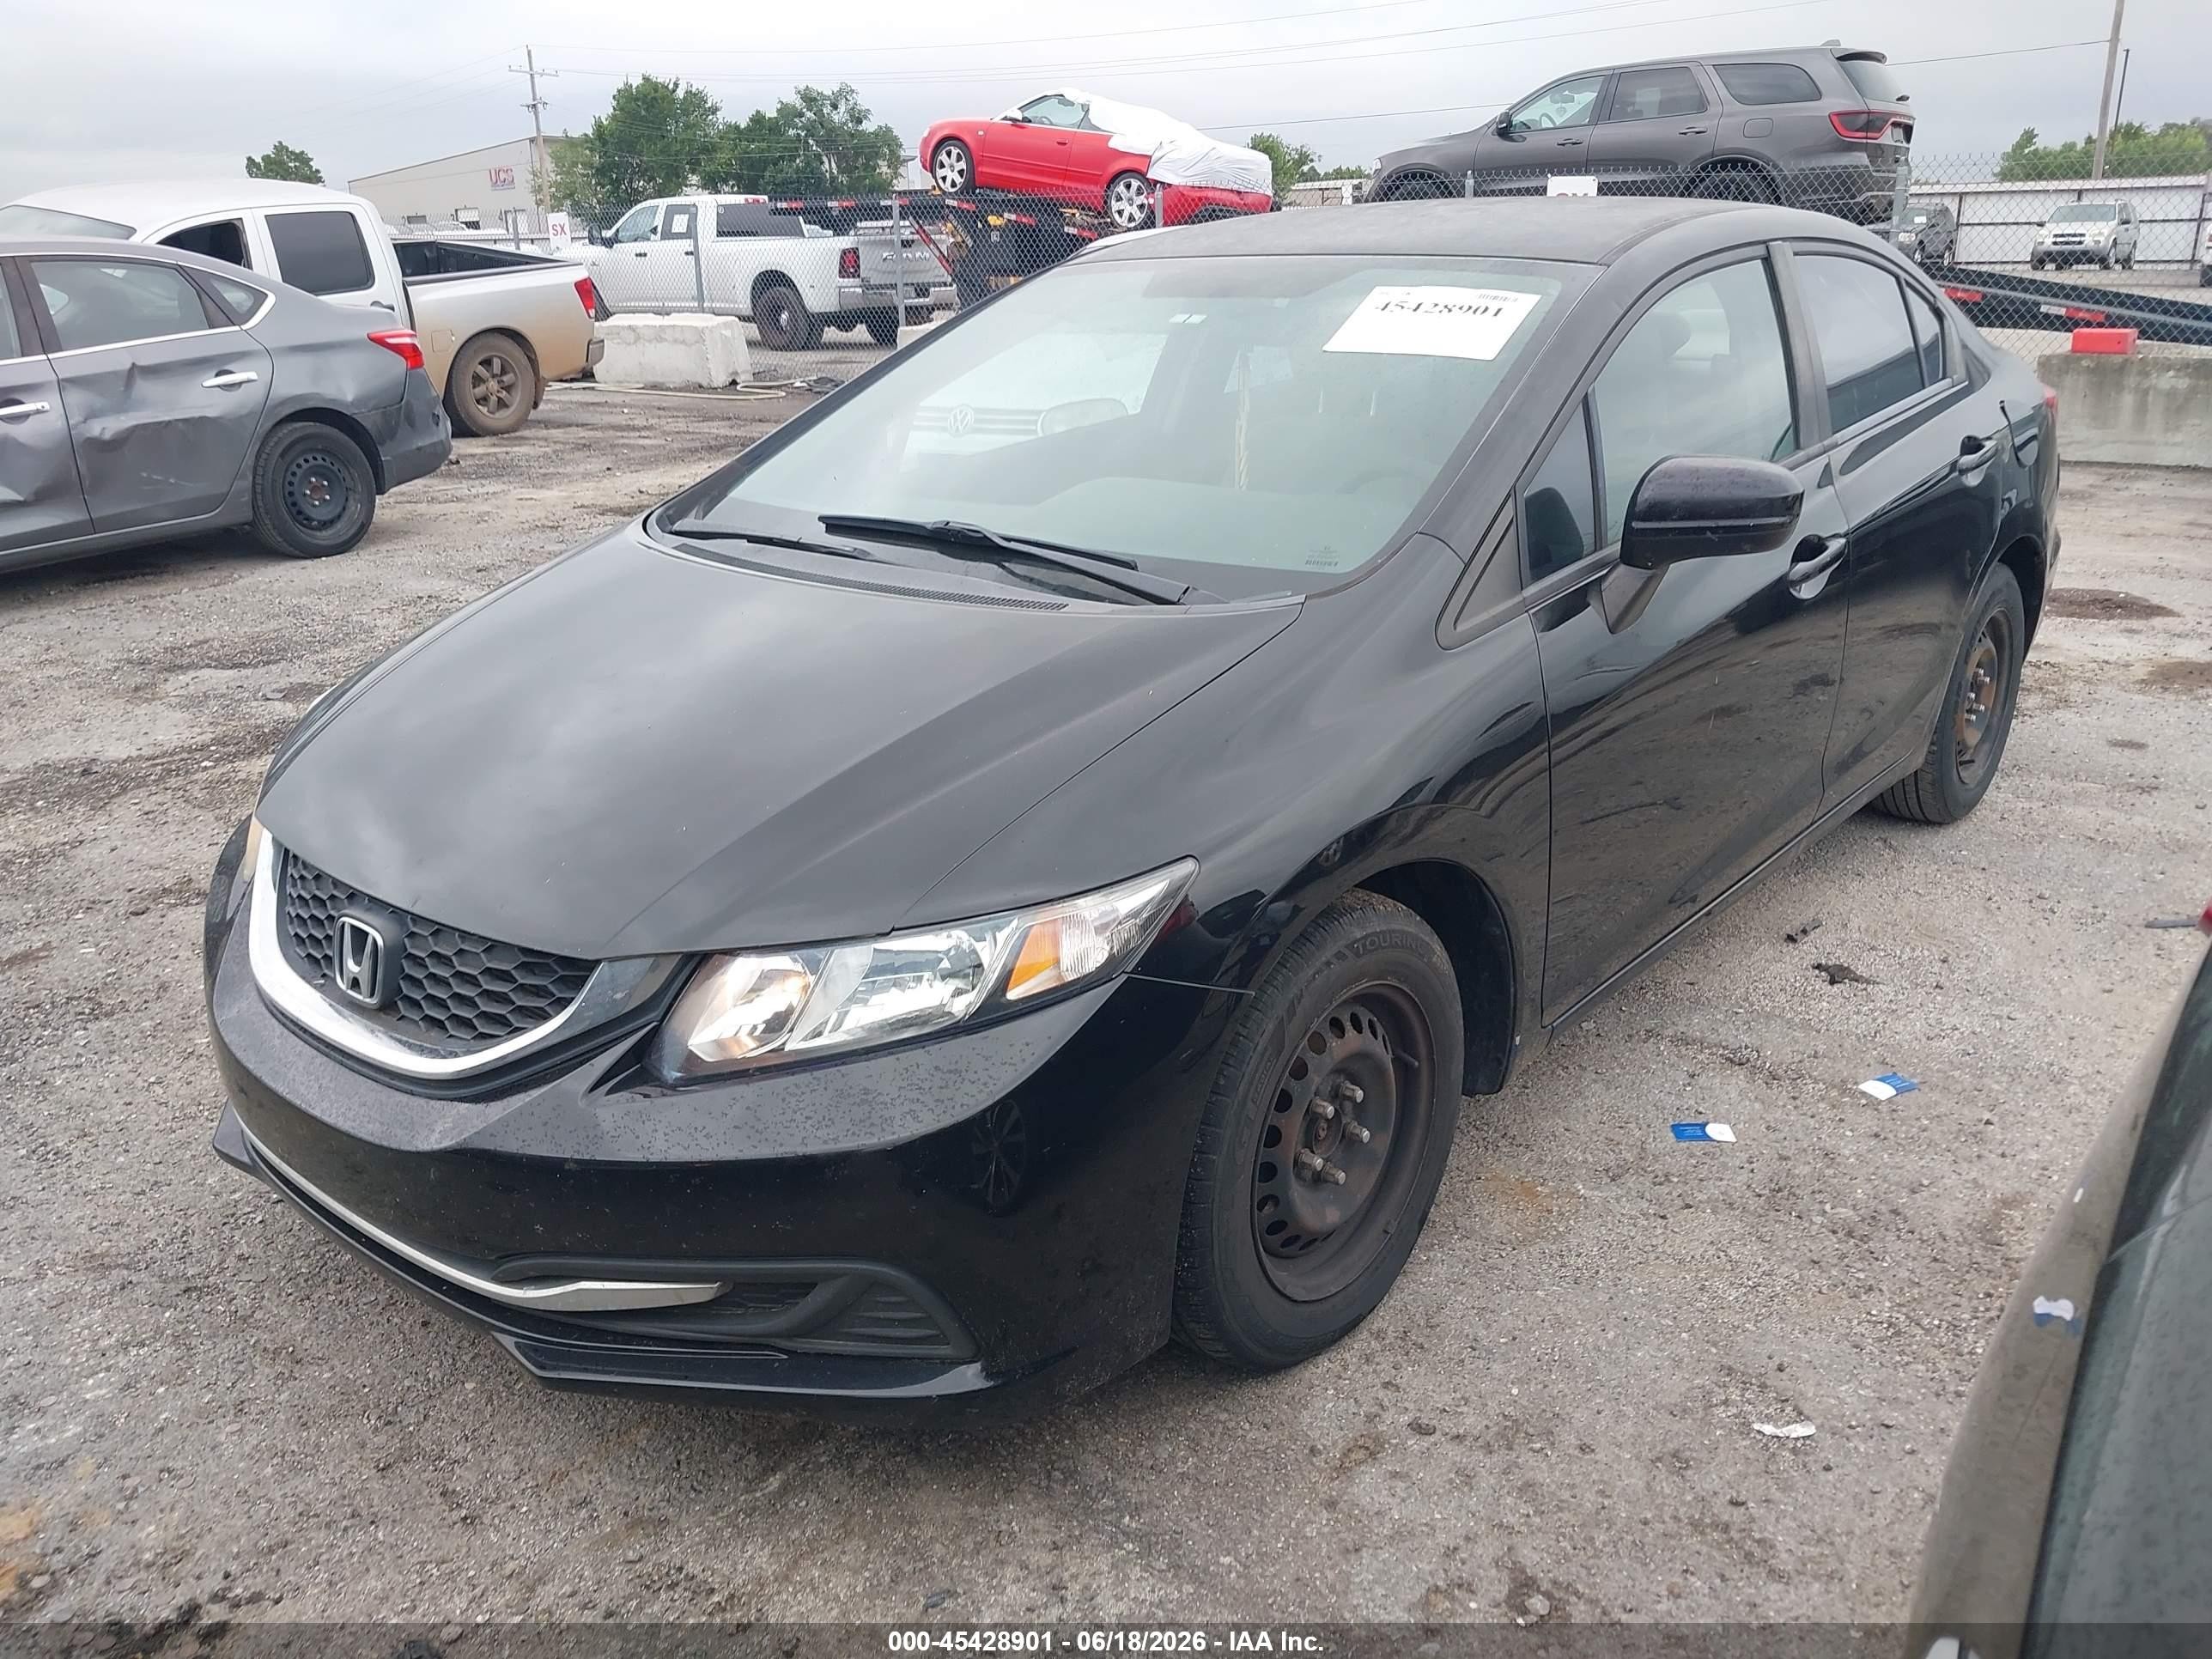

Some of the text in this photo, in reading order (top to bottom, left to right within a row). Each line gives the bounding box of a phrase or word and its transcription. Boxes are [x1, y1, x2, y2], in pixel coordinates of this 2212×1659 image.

[489, 167, 515, 185] UCS
[551, 222, 568, 237] SX
[1374, 300, 1504, 317] 45428901
